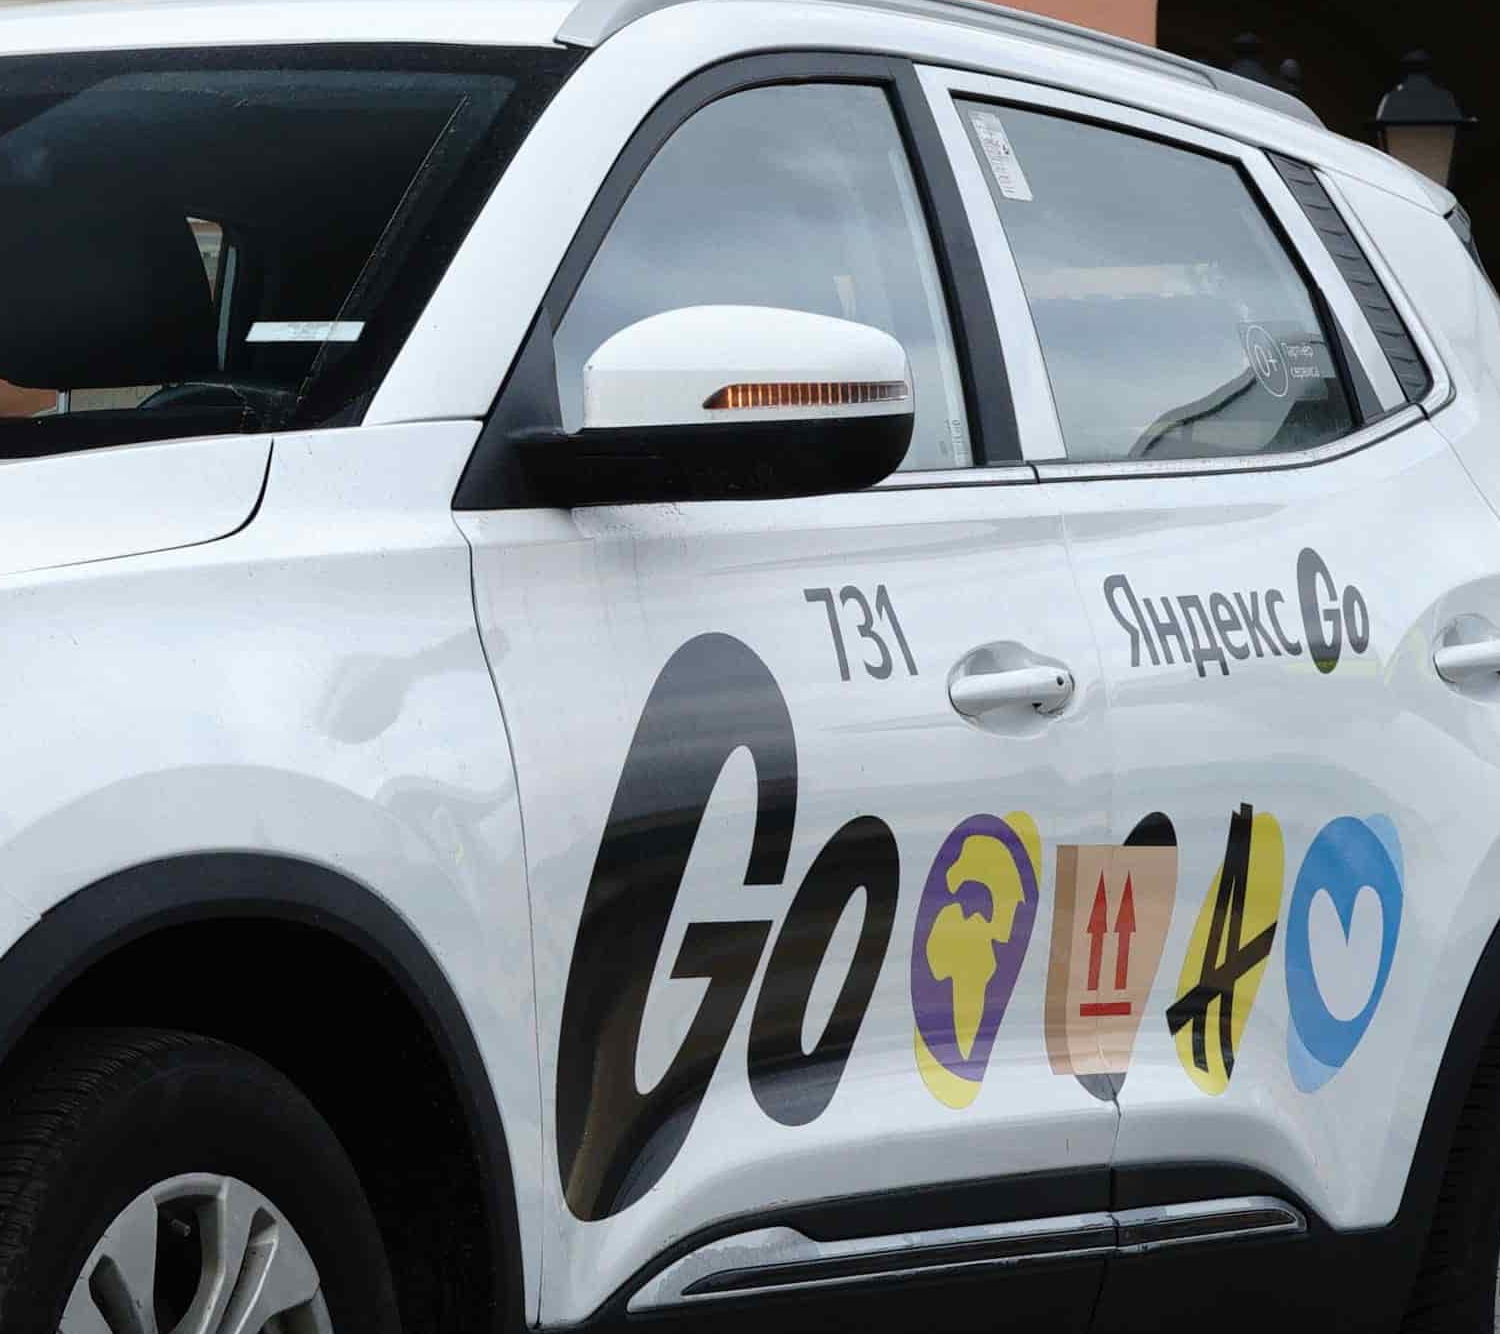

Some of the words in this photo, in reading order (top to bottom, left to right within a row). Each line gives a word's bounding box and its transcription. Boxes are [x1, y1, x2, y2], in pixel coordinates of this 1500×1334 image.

[804, 585, 918, 681] 731
[1104, 575, 1303, 678] Яндекс
[1297, 547, 1369, 674] Go
[556, 634, 900, 1223] Go
